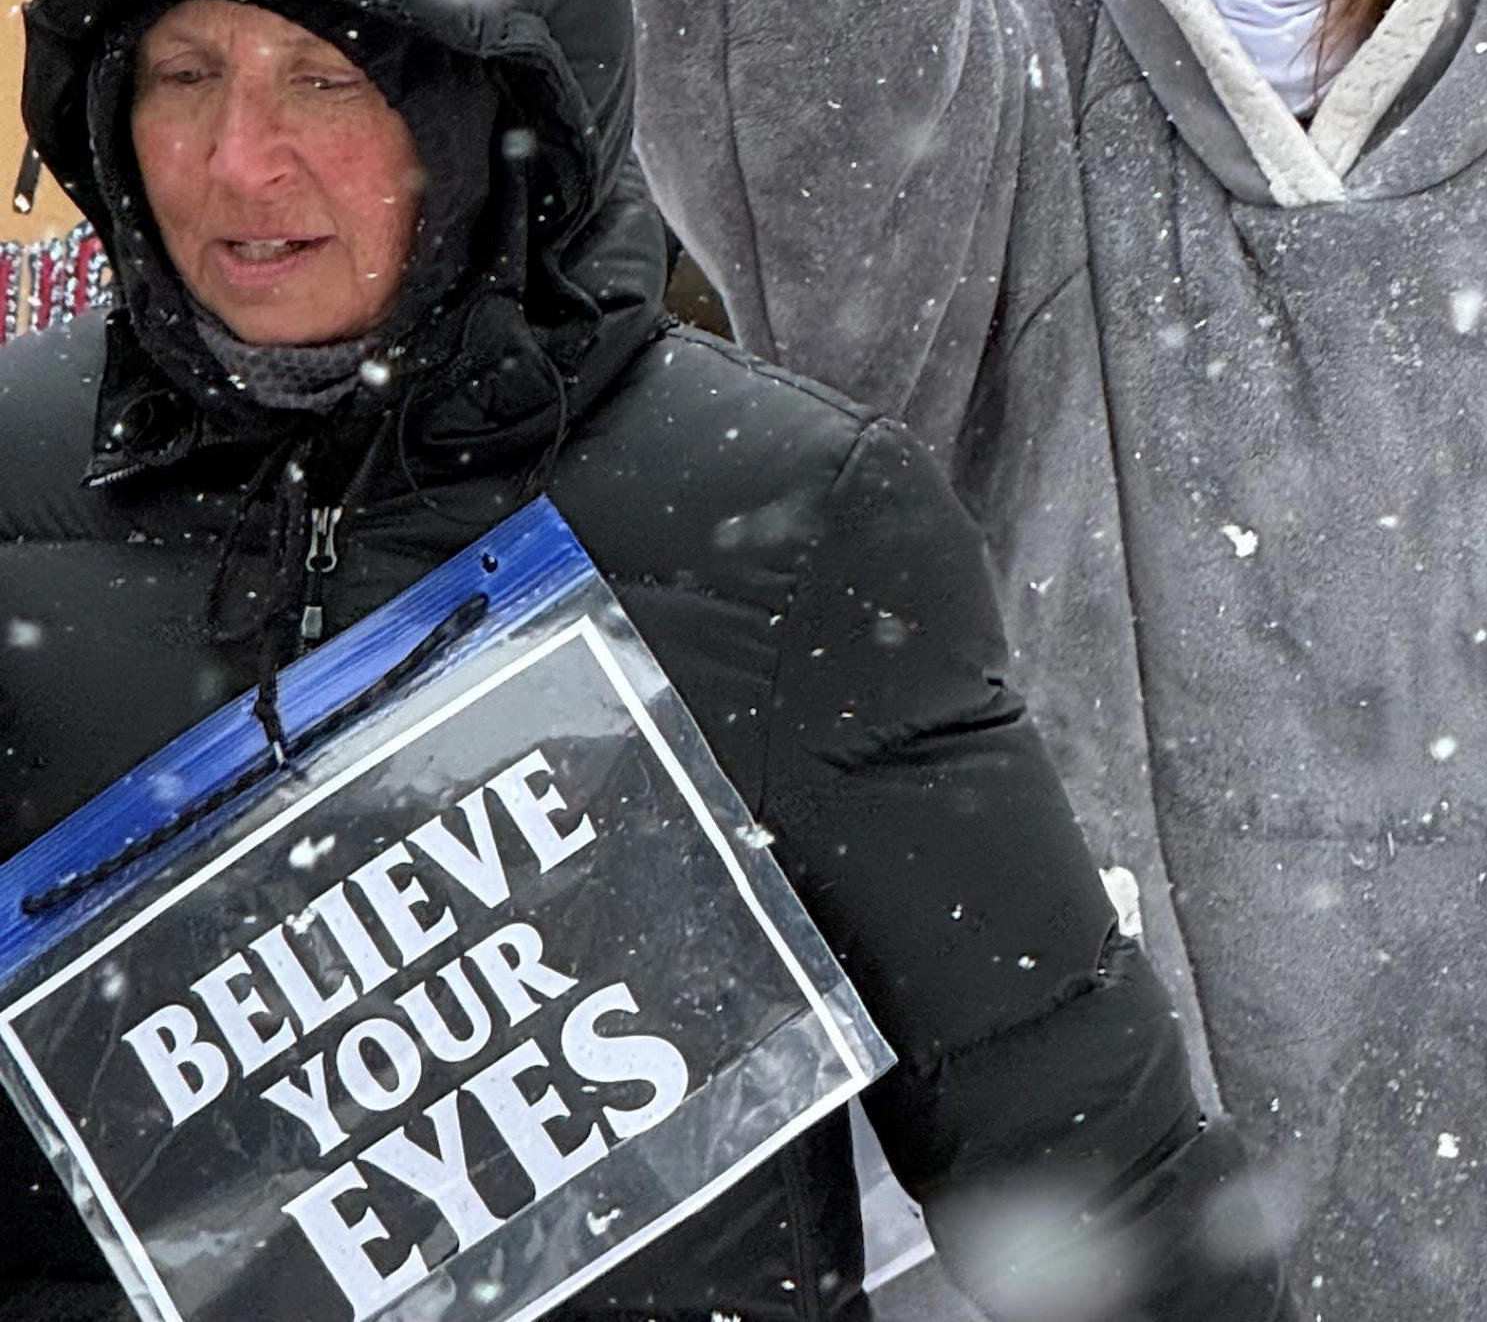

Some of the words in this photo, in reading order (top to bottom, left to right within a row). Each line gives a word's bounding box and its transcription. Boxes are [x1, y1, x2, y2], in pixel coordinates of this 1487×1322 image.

[121, 748, 599, 1128] BELIEVE
[260, 922, 579, 1159] YOUR
[281, 982, 689, 1322] EYES
